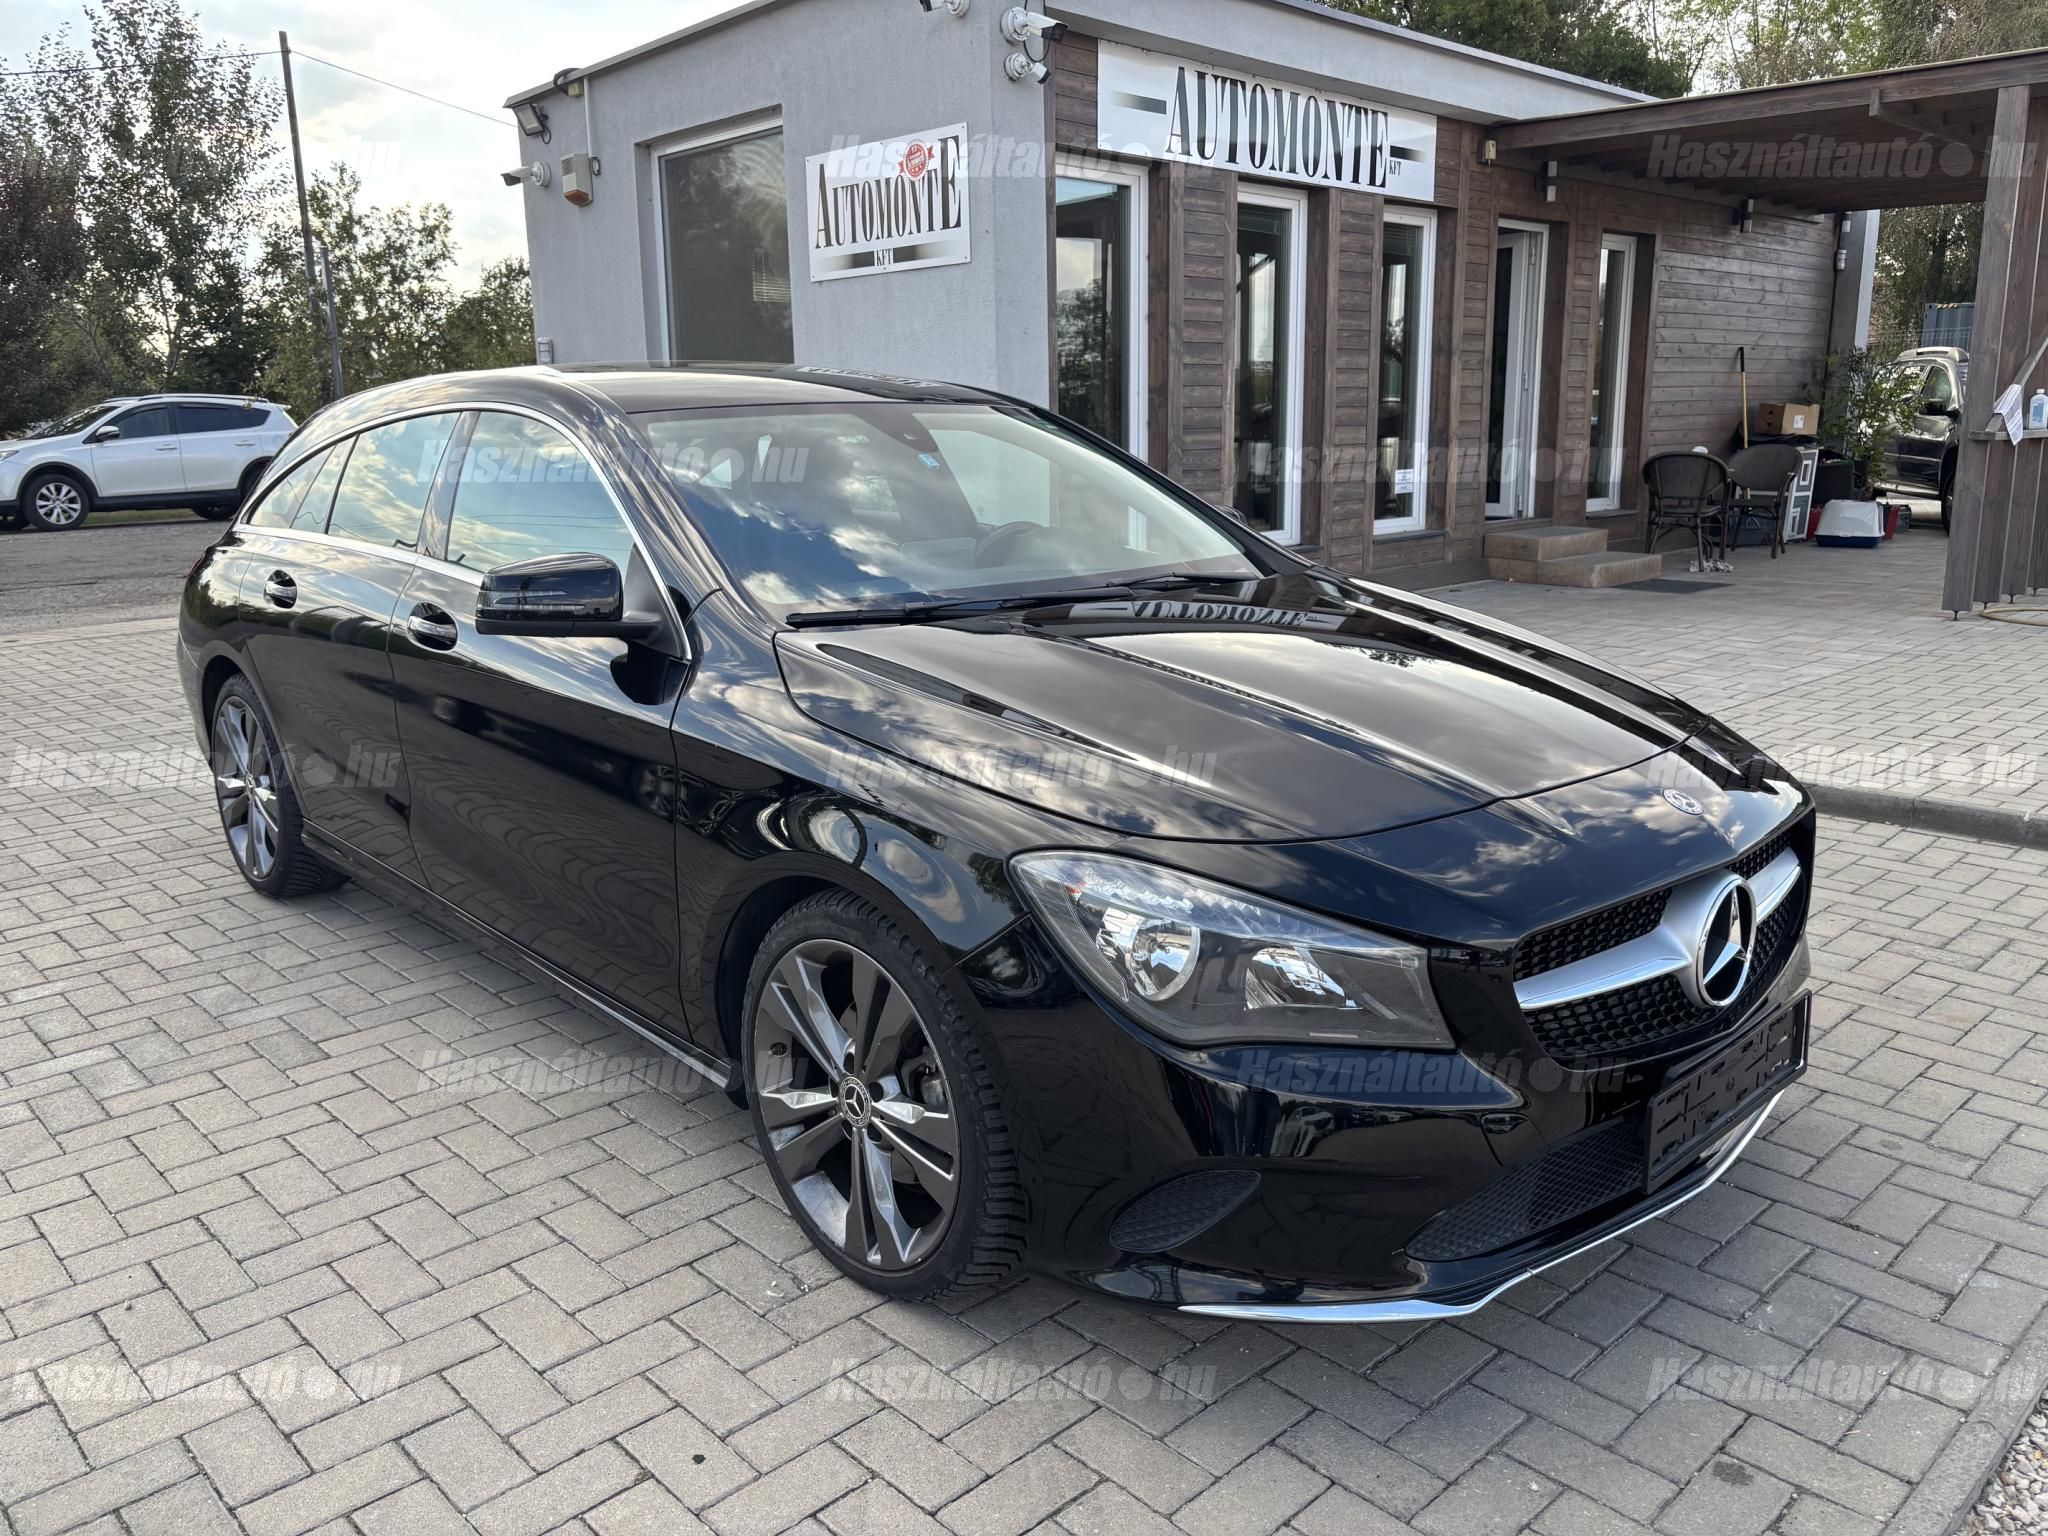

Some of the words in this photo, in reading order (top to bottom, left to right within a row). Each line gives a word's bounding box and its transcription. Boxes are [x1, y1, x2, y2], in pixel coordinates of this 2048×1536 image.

[1165, 66, 1389, 188] AUTOMONTE
[816, 135, 961, 249] AUTOMONTE
[1389, 157, 1402, 176] KFT
[876, 248, 893, 267] KFT
